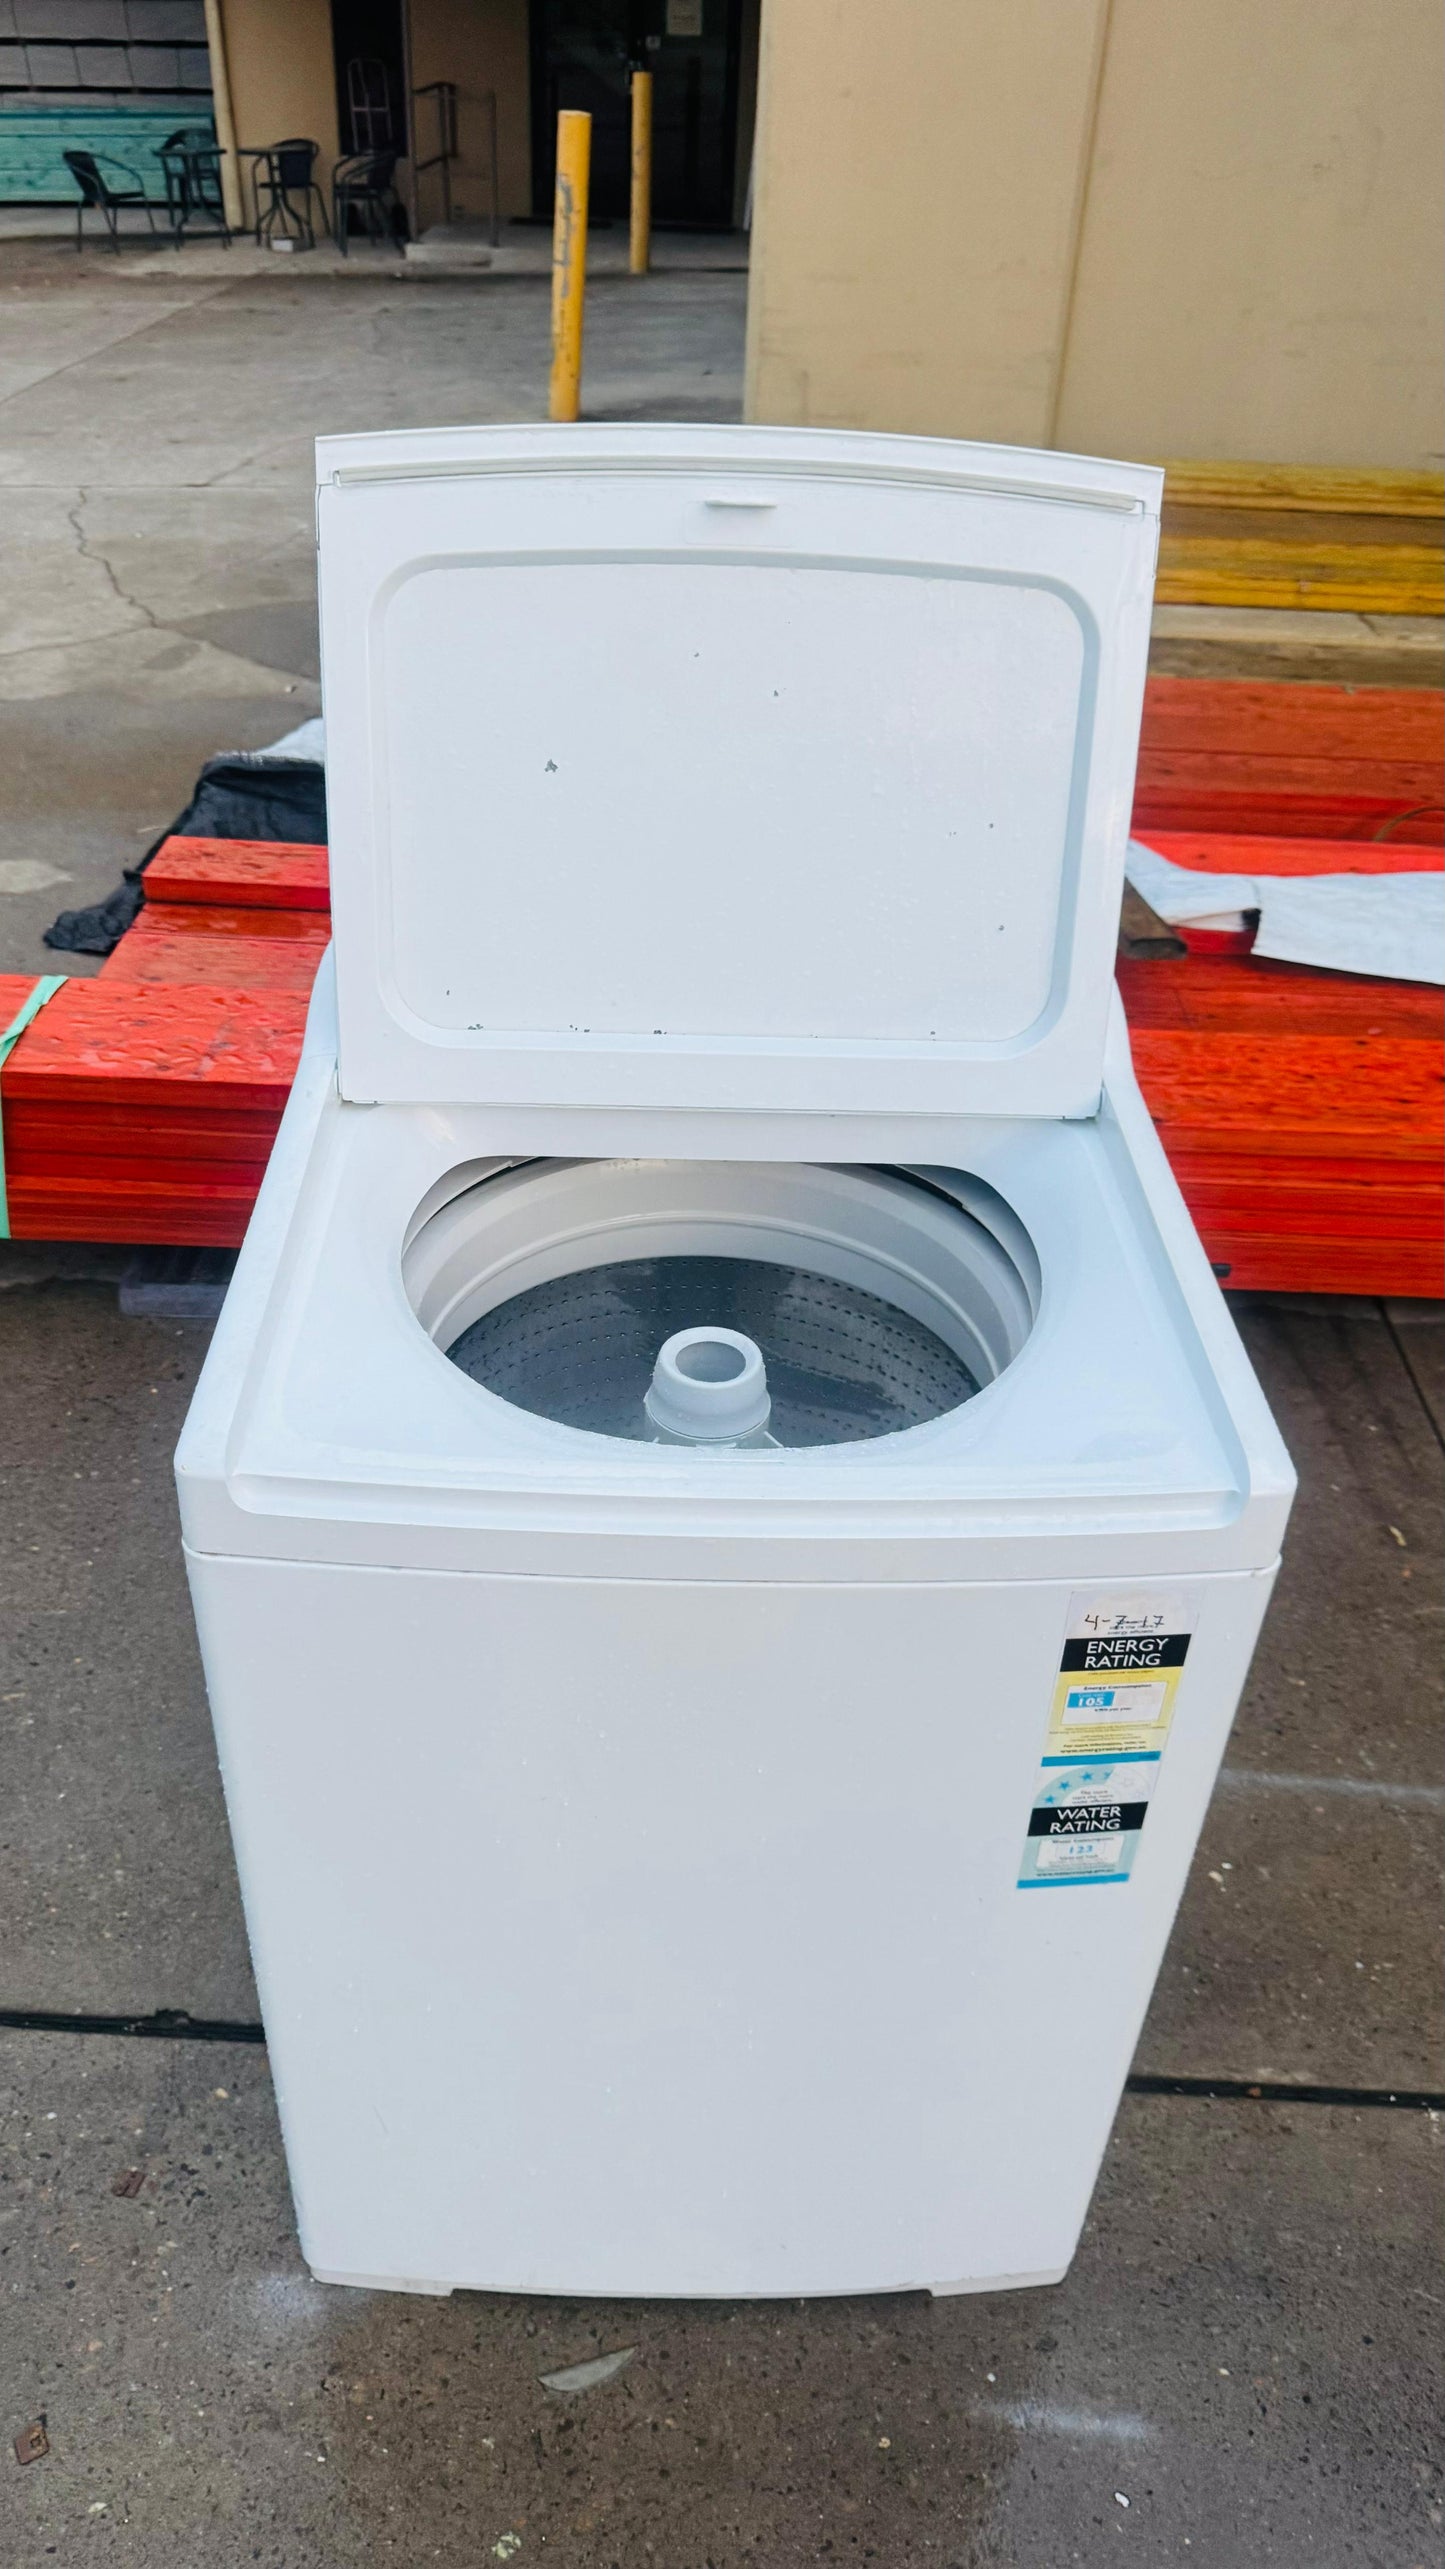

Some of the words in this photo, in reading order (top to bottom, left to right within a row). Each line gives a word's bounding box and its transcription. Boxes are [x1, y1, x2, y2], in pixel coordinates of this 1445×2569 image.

[1086, 1638, 1169, 1654] ENERGY
[1084, 1653, 1161, 1669] RATING
[1078, 1697, 1105, 1707] 105
[1057, 1806, 1121, 1820] WATER
[1049, 1818, 1121, 1834] RATING
